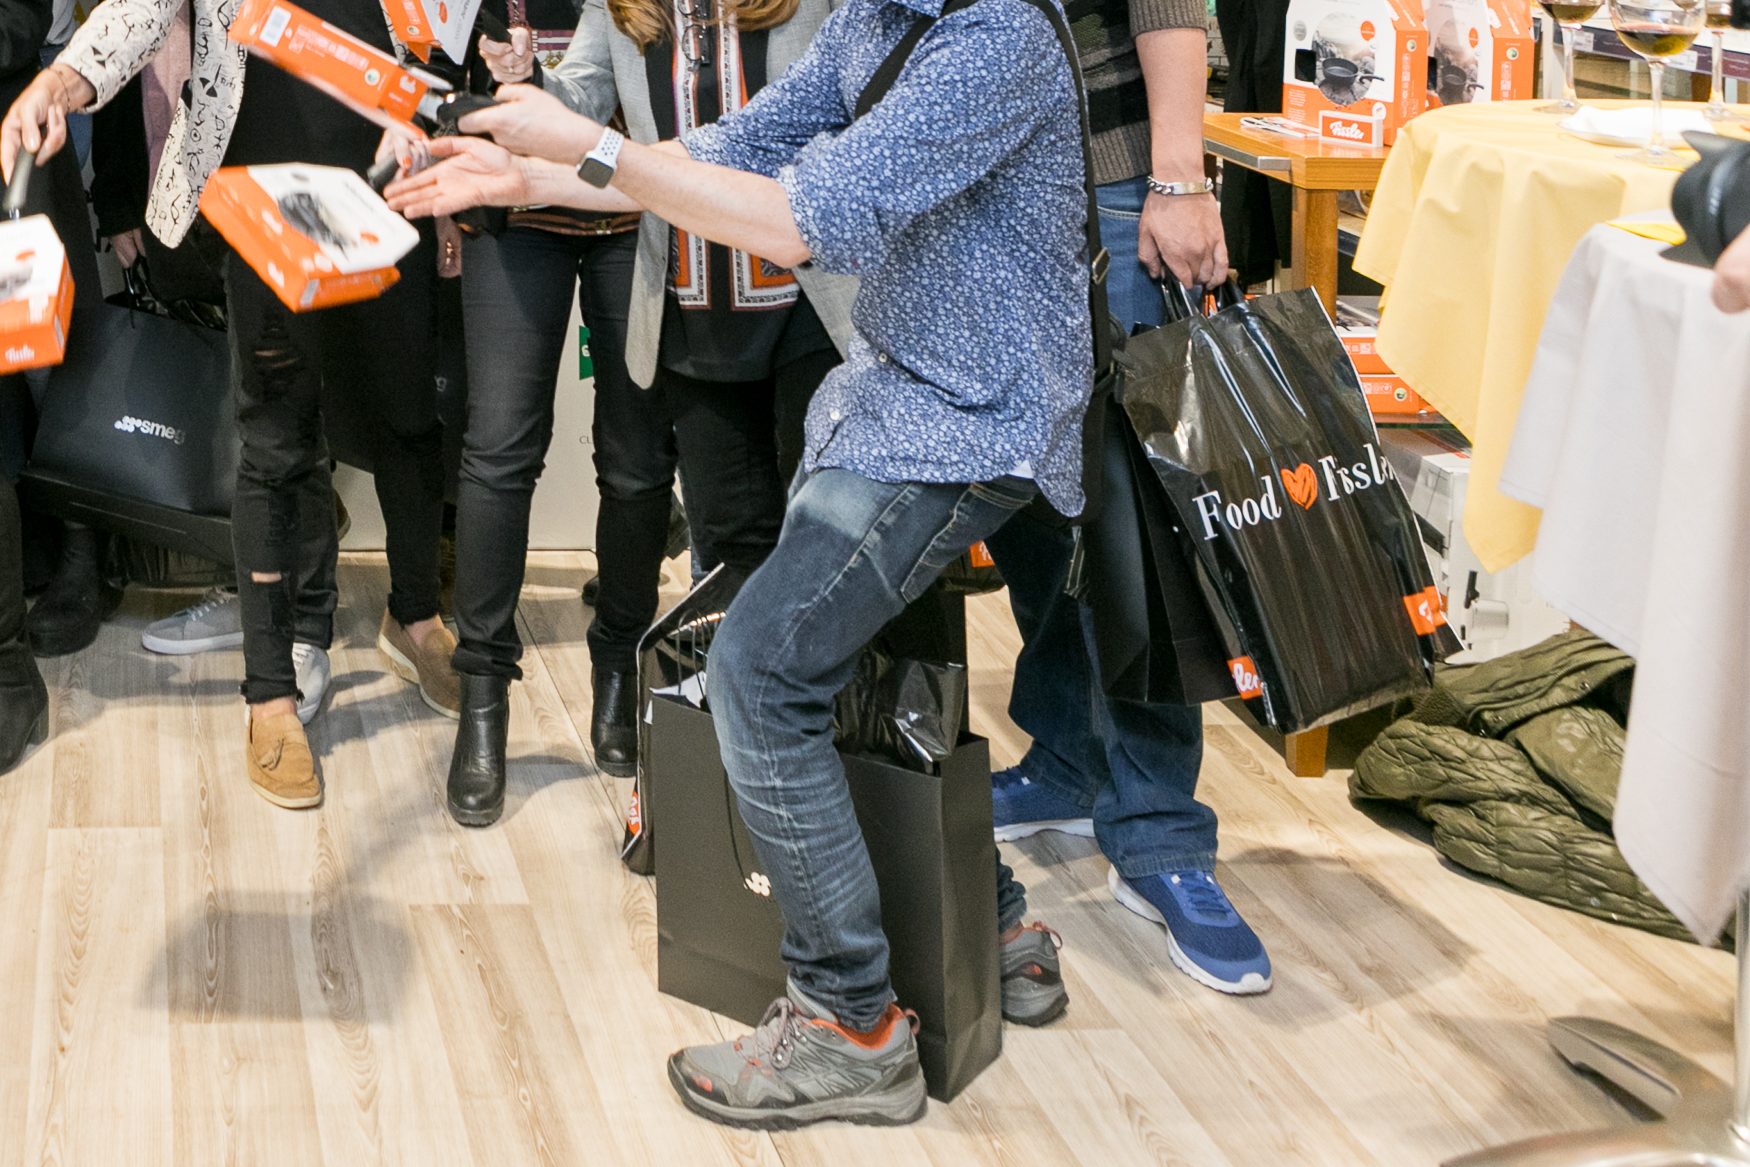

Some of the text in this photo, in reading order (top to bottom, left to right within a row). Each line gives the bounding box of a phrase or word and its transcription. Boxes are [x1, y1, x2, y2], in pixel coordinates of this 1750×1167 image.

[1329, 120, 1365, 140] Fissler
[140, 419, 186, 445] smeg
[1192, 475, 1282, 541] Food
